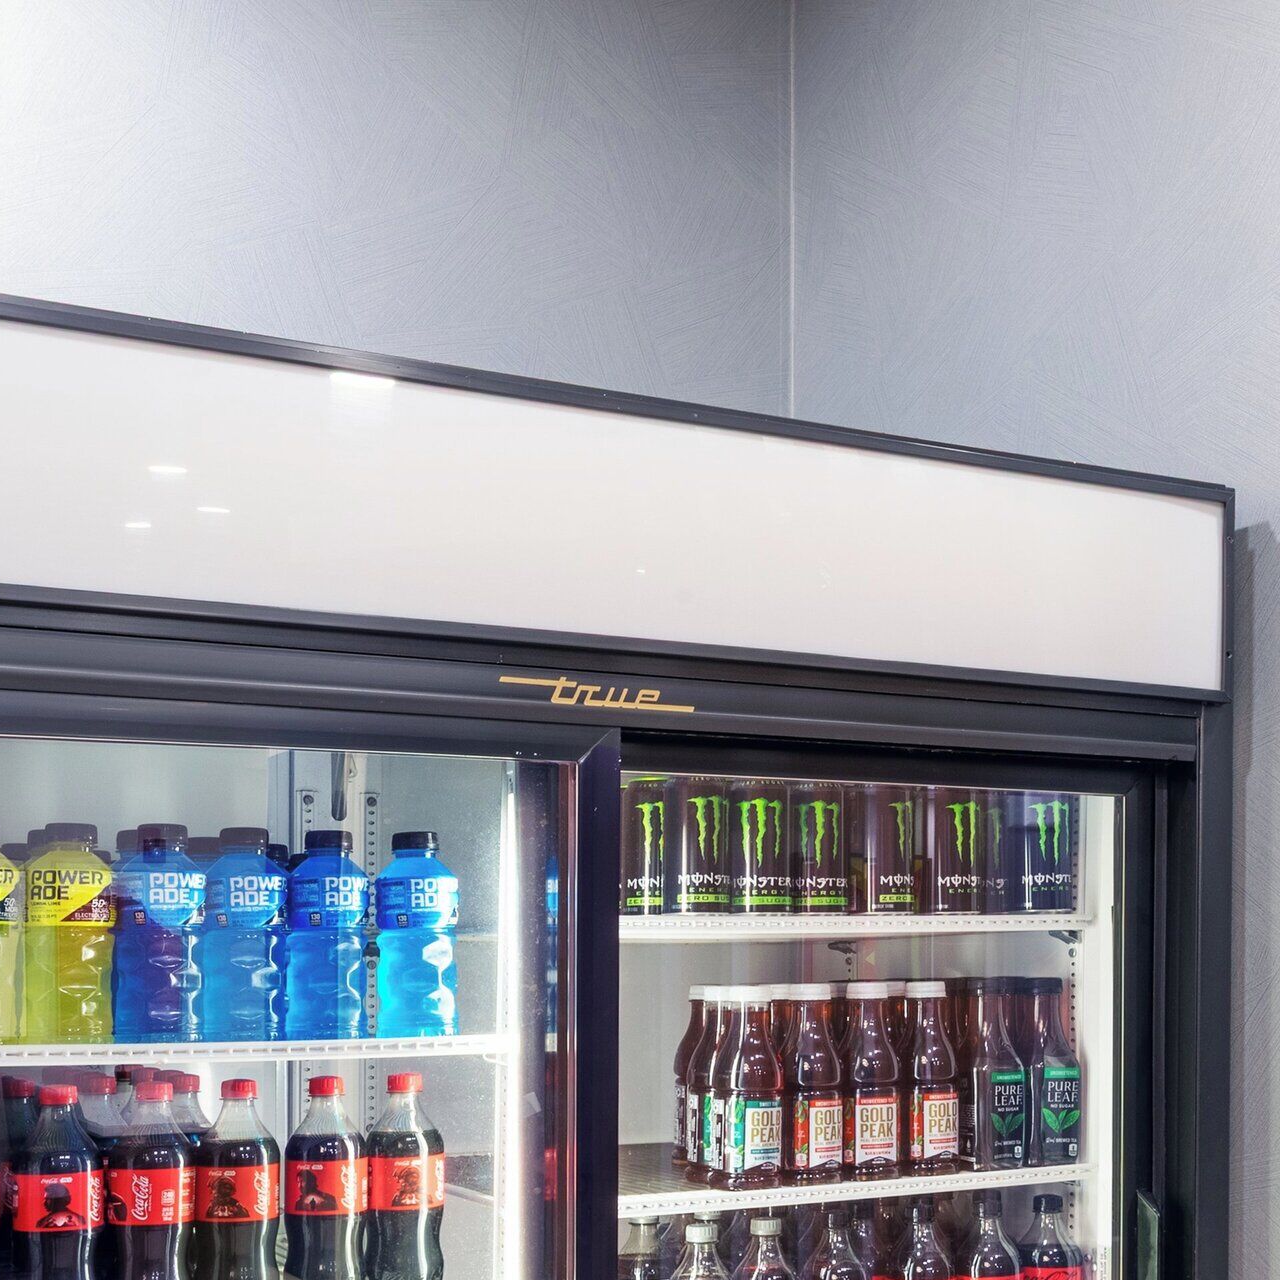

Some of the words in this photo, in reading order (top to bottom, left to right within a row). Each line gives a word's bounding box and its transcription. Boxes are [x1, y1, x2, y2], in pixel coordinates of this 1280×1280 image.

[499, 676, 695, 712] true
[31, 870, 103, 885] POWER
[734, 875, 792, 888] ONSTER
[794, 876, 848, 889] ONSTER
[30, 885, 69, 900] ADE
[149, 888, 190, 904] ADE
[230, 891, 270, 907] ADE
[995, 1084, 1023, 1096] PURE
[1048, 1080, 1079, 1092] PURE
[995, 1095, 1021, 1106] LEAF
[1048, 1091, 1078, 1103] LEAF
[860, 1106, 894, 1123] GOLD
[928, 1101, 958, 1118] GOLD
[860, 1122, 894, 1138] PEAK
[928, 1117, 958, 1133] PEAK
